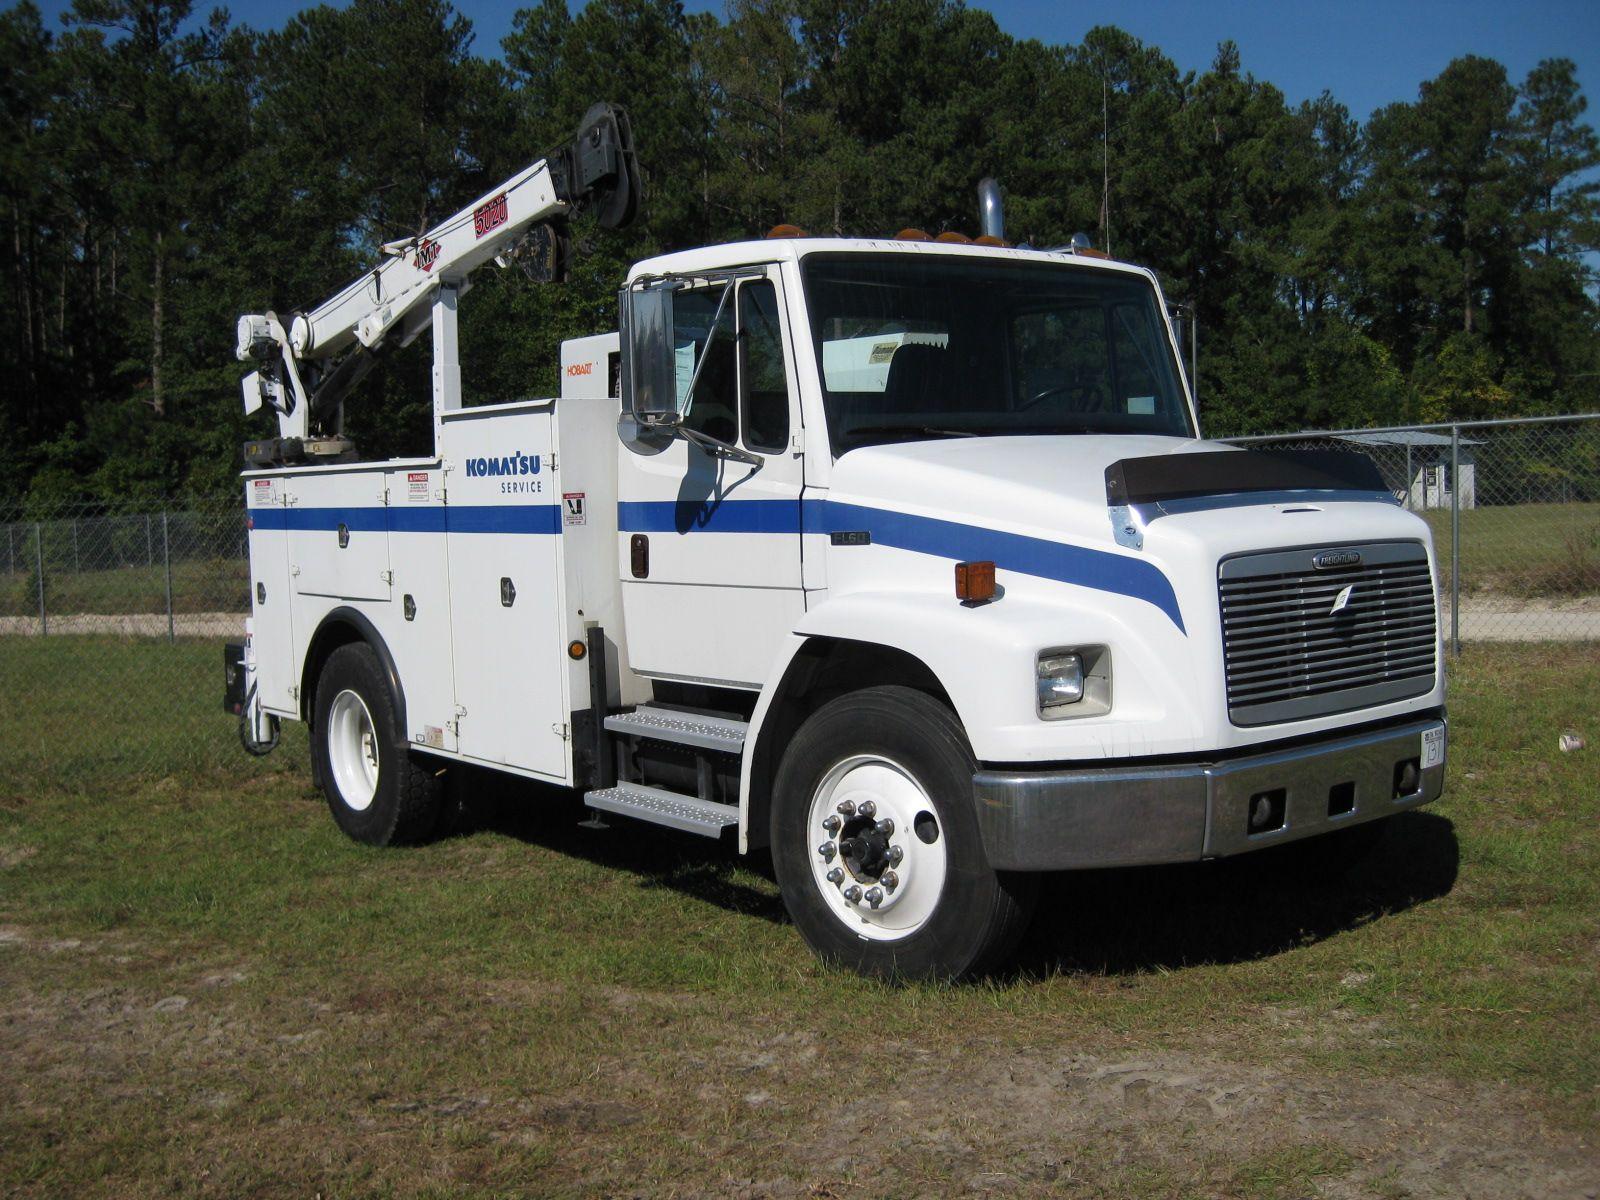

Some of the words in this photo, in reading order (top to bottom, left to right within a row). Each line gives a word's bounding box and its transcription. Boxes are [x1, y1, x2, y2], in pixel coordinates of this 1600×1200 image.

[475, 195, 506, 236] 5020
[416, 241, 438, 270] IMT
[567, 363, 593, 376] HOBART
[466, 451, 541, 477] KOMATSU
[501, 481, 542, 493] SERVICE
